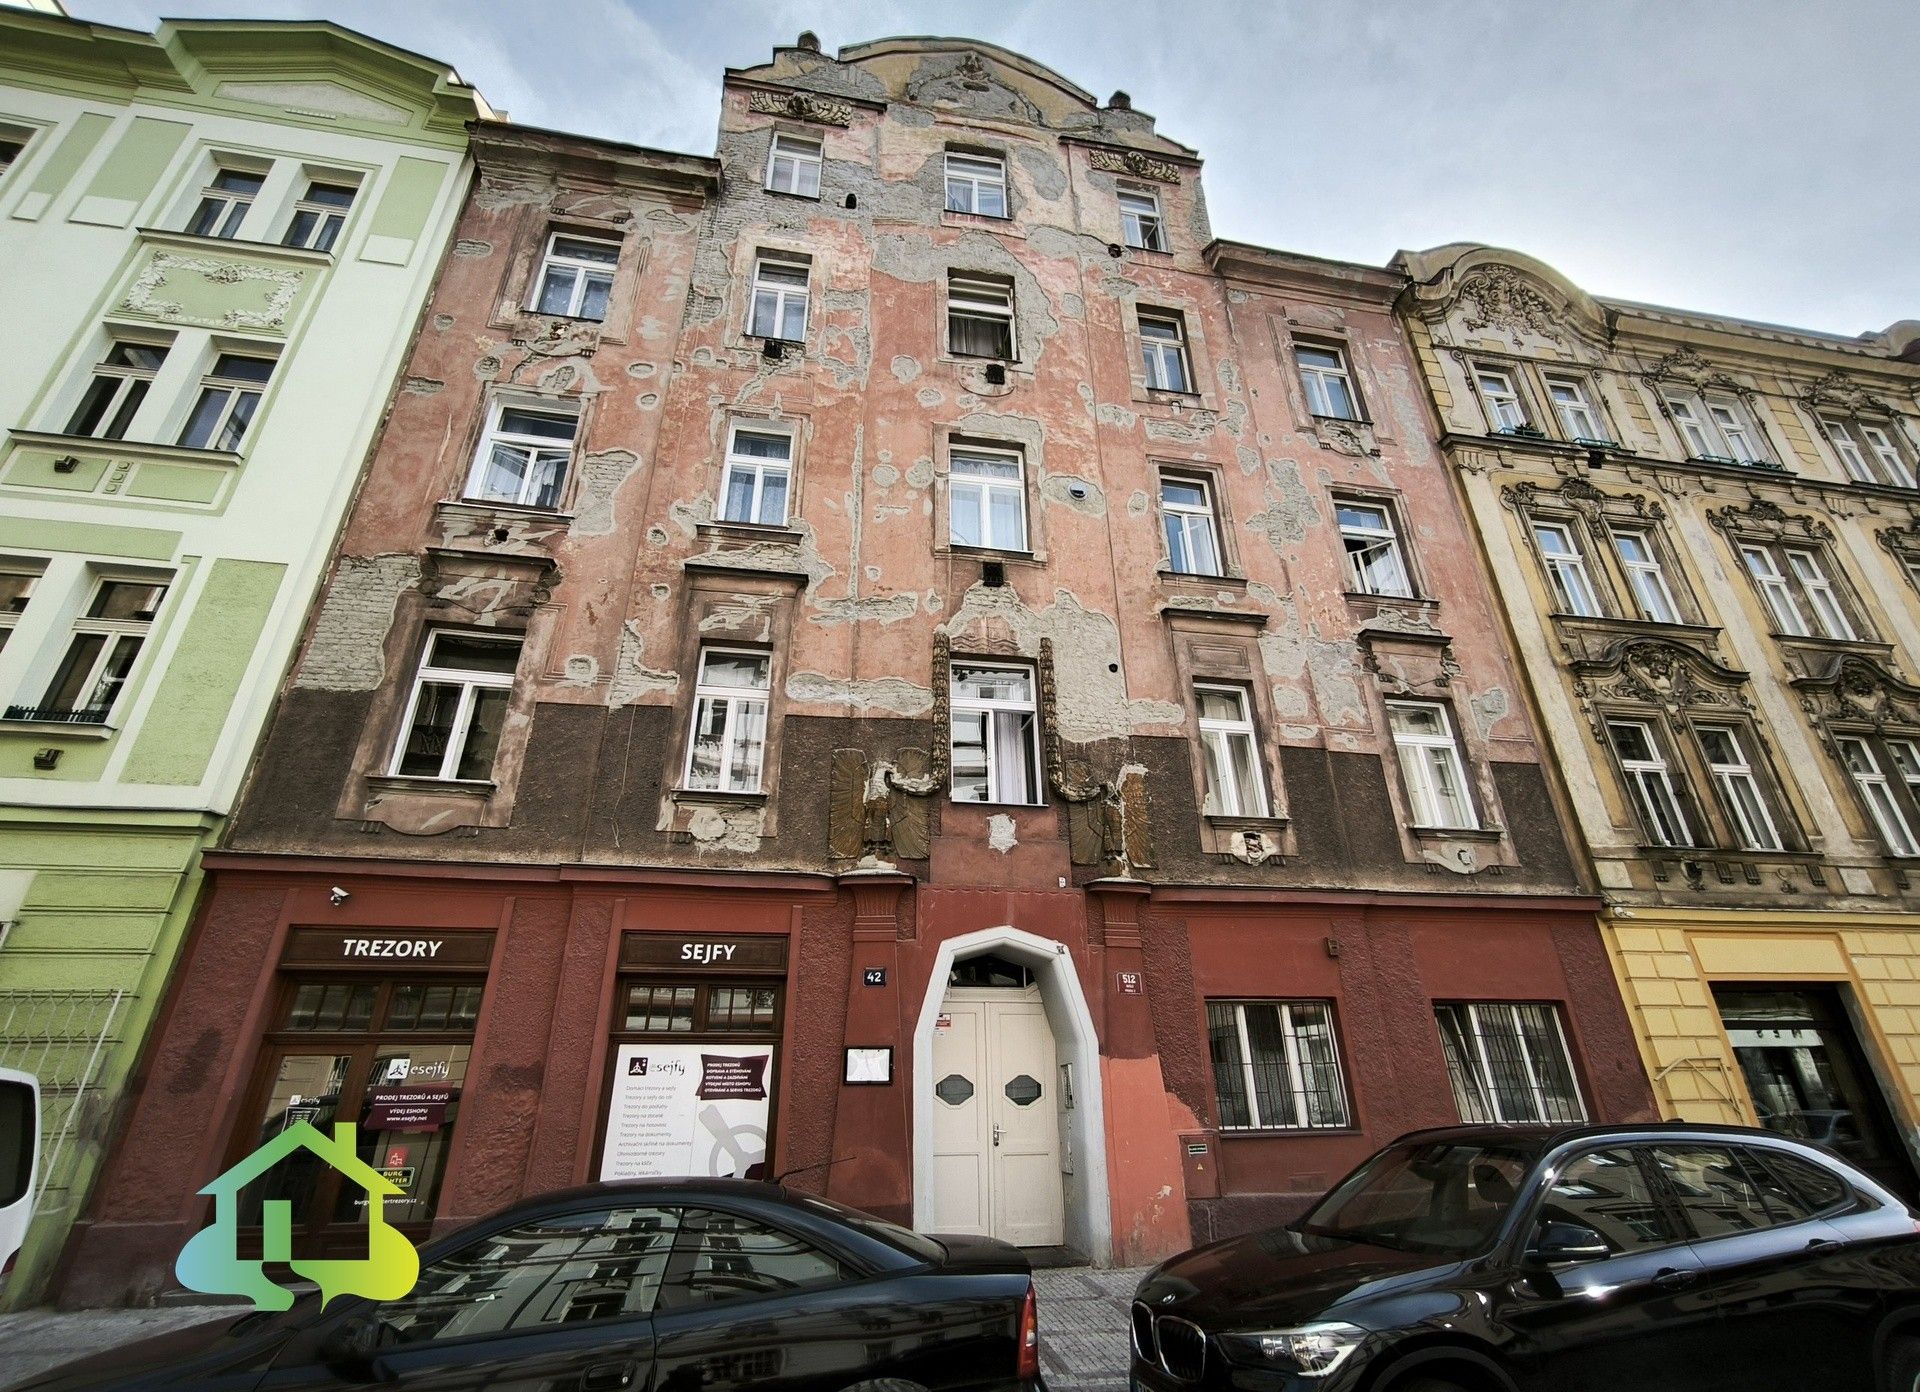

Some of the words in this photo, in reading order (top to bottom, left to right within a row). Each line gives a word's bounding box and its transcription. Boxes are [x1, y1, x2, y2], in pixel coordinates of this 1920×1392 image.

[343, 939, 443, 957] TREZORY
[680, 943, 737, 964] SEJFY
[867, 971, 882, 982] 42
[1122, 974, 1136, 984] 512
[410, 1061, 451, 1079] esejfy
[375, 1094, 399, 1102] PRODEJ
[400, 1093, 426, 1101] TREZORŮ
[432, 1092, 449, 1102] SEJFŮ
